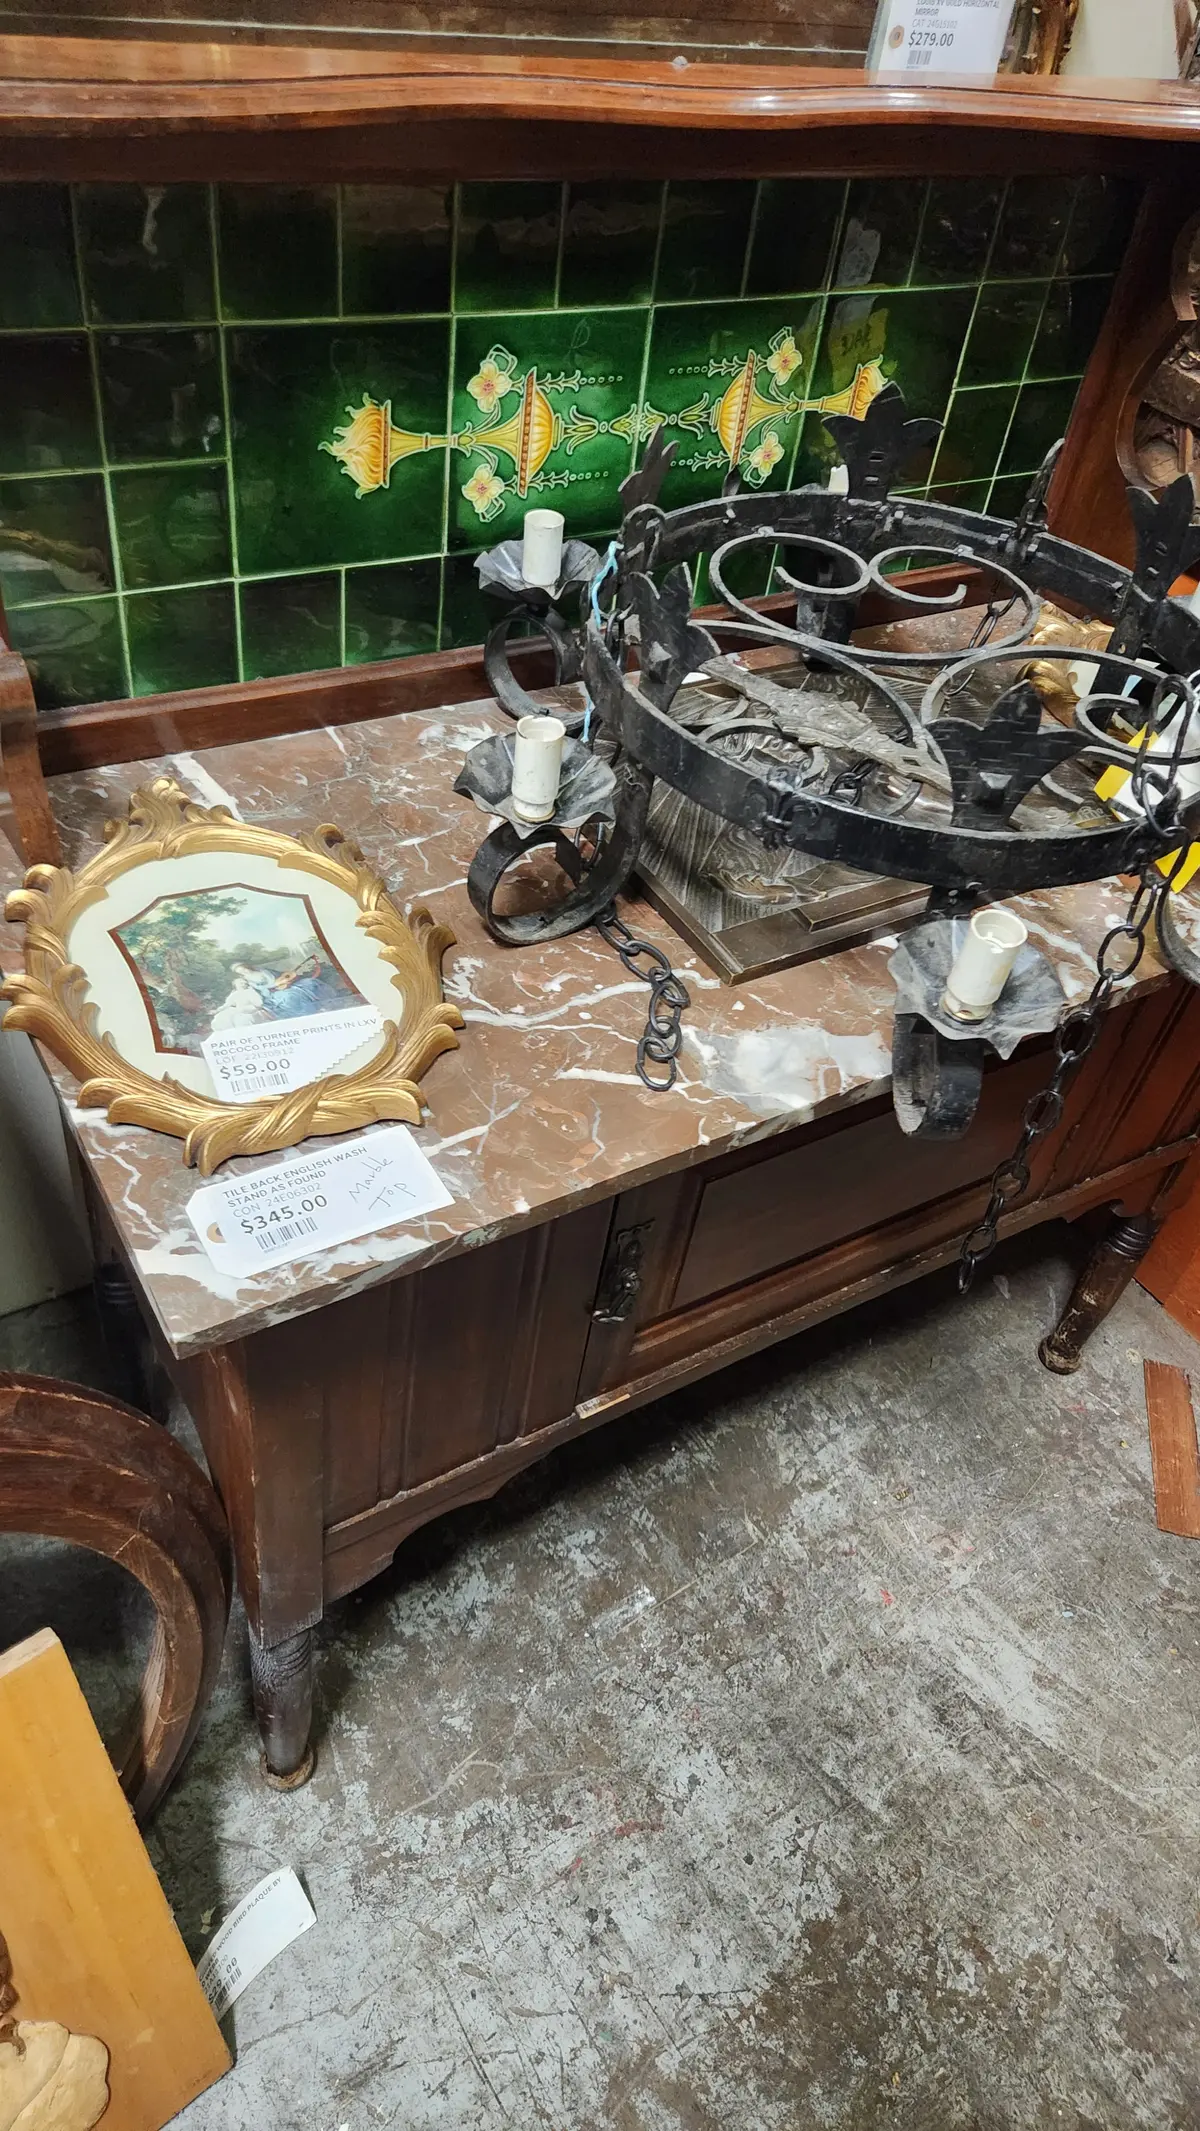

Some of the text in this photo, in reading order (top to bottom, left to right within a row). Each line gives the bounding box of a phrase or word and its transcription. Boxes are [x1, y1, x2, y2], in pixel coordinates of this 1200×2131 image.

[914, 8, 939, 16] MIRROR
[962, 0, 1000, 9] HORIZONTAL
[911, 18, 925, 28] CAT
[908, 29, 954, 48] $279.00
[210, 1039, 237, 1049] PAIR
[239, 1036, 254, 1045] OF
[256, 1030, 301, 1042] TURNER
[302, 1023, 342, 1036] PRINTS
[356, 1018, 377, 1028] LXV
[213, 1037, 301, 1057] ROCOCO FRAME
[219, 1057, 291, 1081] $59.00
[223, 1146, 368, 1199] TILE BACK ENGLISH WASH
[349, 1156, 394, 1204] Marble
[227, 1169, 327, 1208] STAND AS FOUND
[233, 1182, 322, 1218] CON 24E06302
[368, 1182, 416, 1211] Top
[240, 1194, 328, 1235] $345.00
[216, 1927, 234, 1951] WOOD
[233, 1911, 247, 1928] BIRD
[246, 1886, 273, 1911] PLAQUE
[272, 1876, 281, 1887] BY
